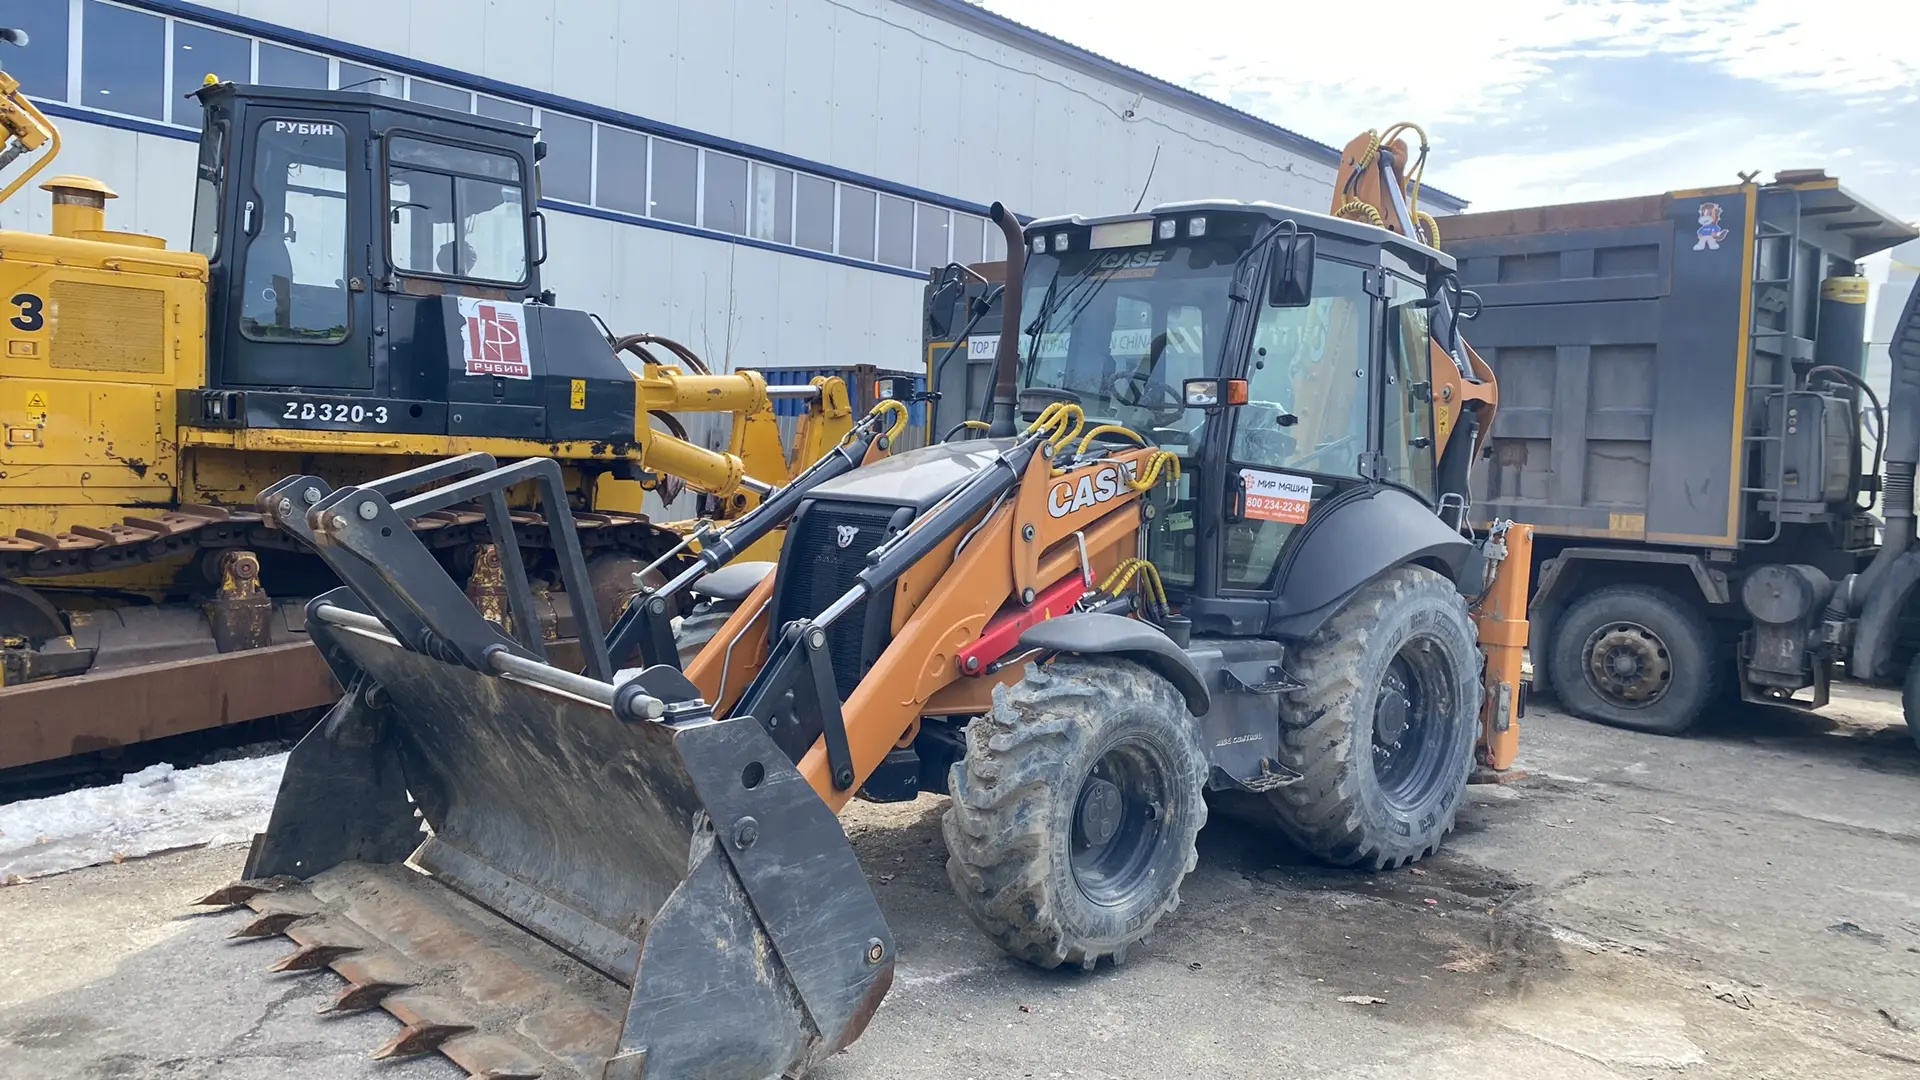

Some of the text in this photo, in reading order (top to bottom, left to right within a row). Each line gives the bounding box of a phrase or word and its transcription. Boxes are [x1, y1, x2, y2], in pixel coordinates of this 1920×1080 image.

[275, 121, 334, 136] РУБИН
[1100, 249, 1167, 269] CASE
[10, 293, 44, 332] 3
[971, 341, 990, 354] TOP
[474, 362, 524, 374] РУБИН
[283, 402, 388, 424] ZD320-3
[1047, 458, 1138, 518] CASE
[1257, 479, 1310, 494] МИР МАШИН
[1246, 497, 1263, 508] 800
[1264, 499, 1306, 514] 234-22-84
